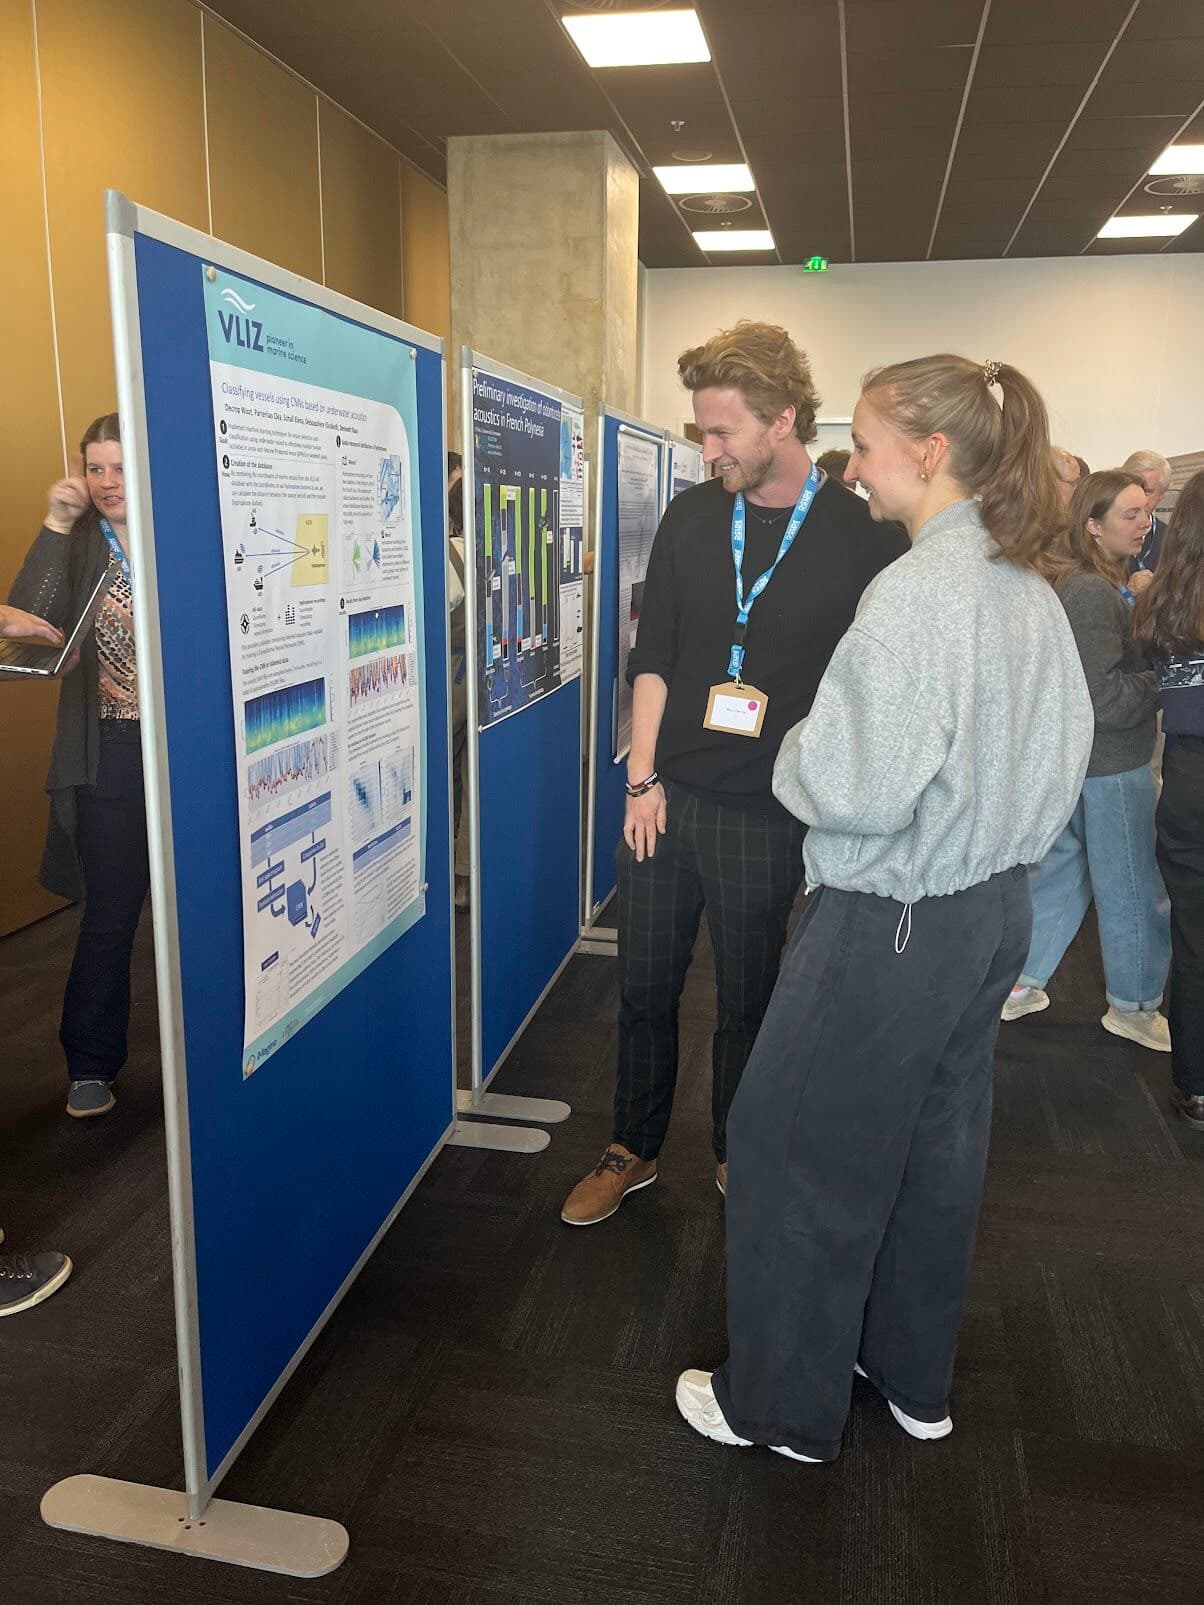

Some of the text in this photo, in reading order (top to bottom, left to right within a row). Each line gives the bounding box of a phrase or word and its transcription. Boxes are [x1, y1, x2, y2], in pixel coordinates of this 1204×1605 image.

[218, 310, 263, 352] VLIZ
[267, 333, 294, 349] pioneer in
[267, 346, 307, 364] marine science
[222, 383, 254, 401] Classifying
[255, 392, 274, 403] vessels
[276, 395, 290, 408] using
[291, 397, 304, 409] CNNs
[305, 400, 319, 412] based
[473, 379, 506, 408] Preliminary
[507, 388, 536, 414] investigation
[538, 400, 543, 414] of
[474, 408, 545, 438] acoustics in French Polynesia
